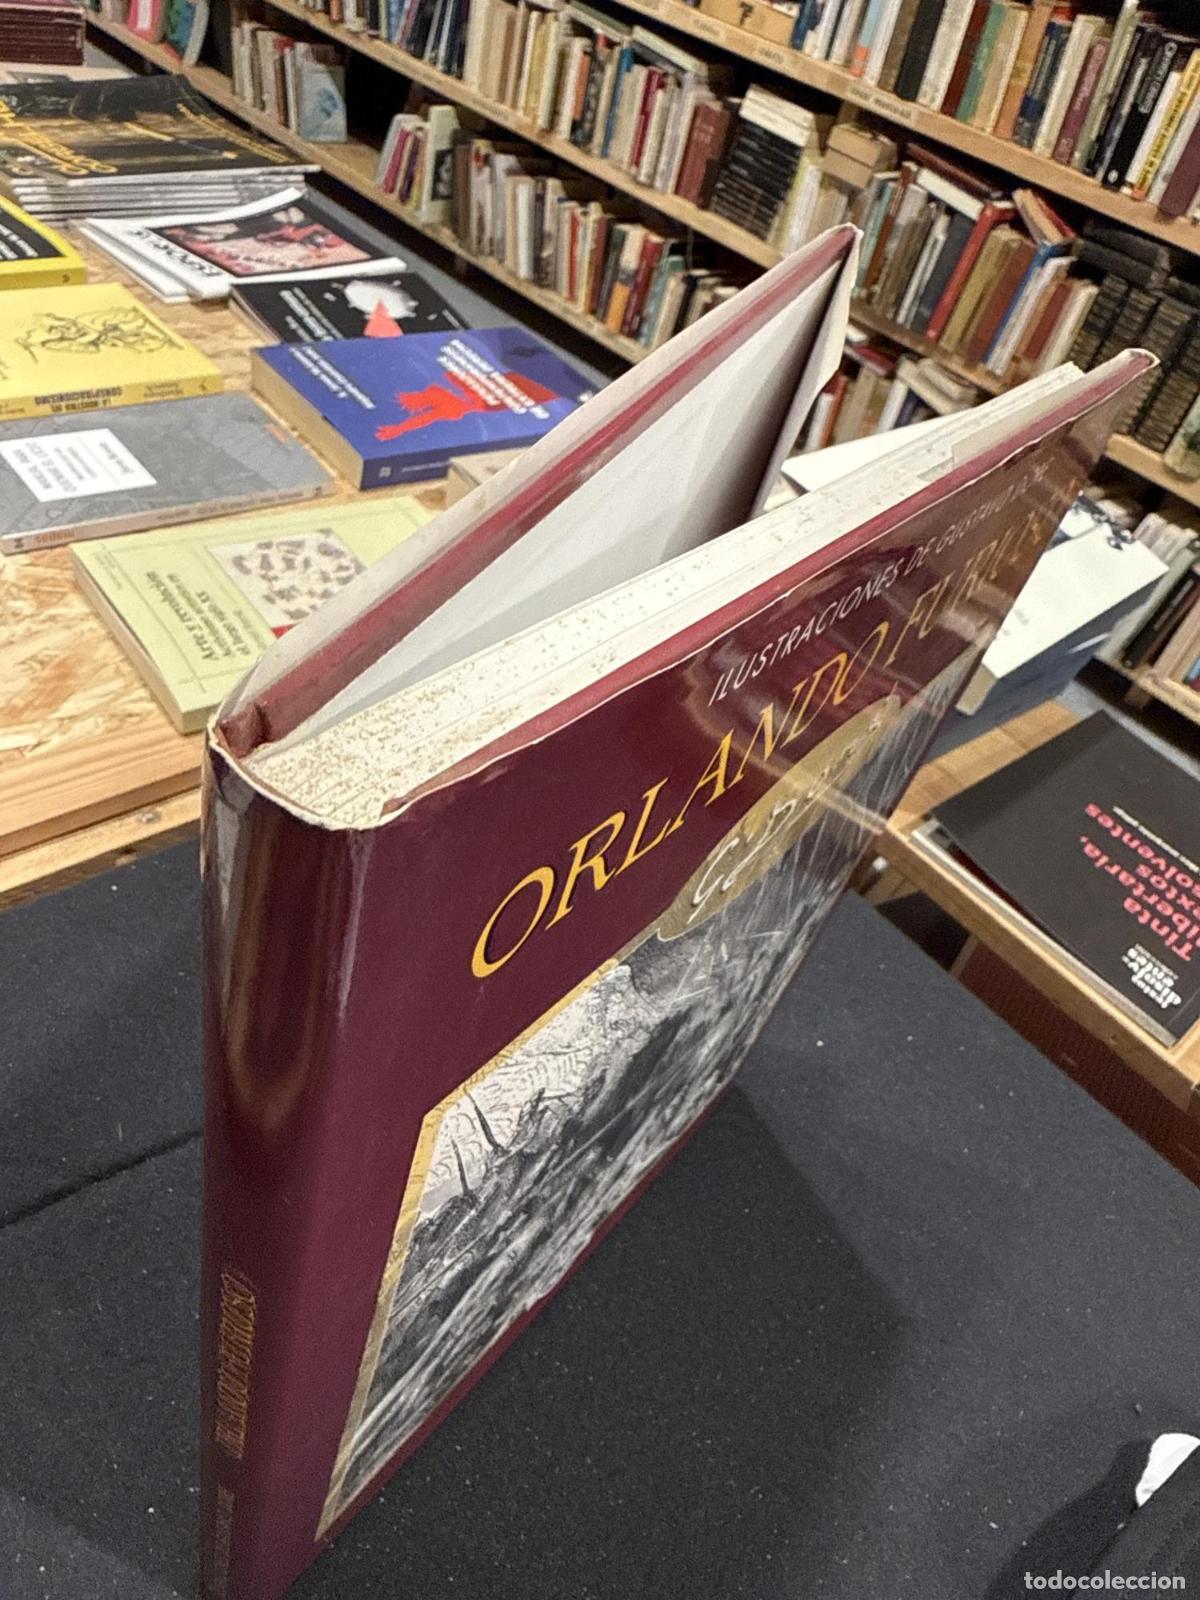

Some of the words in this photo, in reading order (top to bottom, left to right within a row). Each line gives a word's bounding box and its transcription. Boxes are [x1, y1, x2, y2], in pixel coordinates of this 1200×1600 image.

[146, 571, 194, 624] revolución
[708, 557, 905, 707] ILUSTRACIONES
[904, 536, 938, 577] DE
[193, 631, 220, 661] Arte
[471, 620, 890, 980] ORLANDO
[1123, 896, 1192, 962] Tinta
